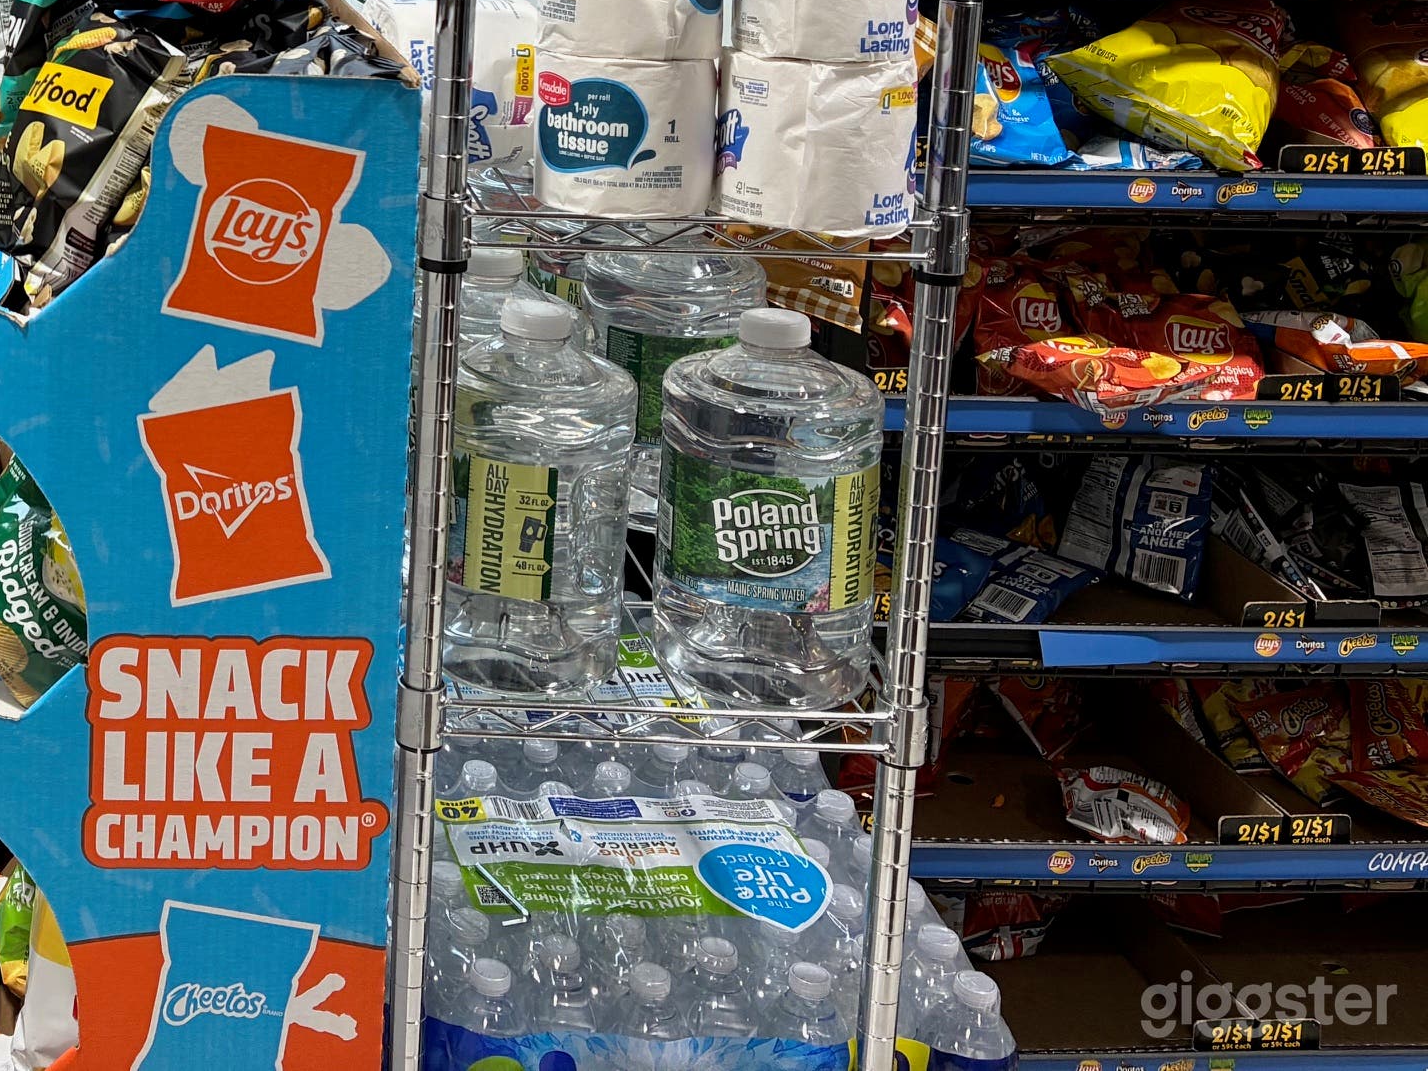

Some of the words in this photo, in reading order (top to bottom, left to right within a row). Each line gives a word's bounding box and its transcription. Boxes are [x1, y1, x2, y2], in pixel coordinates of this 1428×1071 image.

[867, 19, 904, 39] Long
[860, 36, 910, 55] Lasting
[574, 101, 600, 116] 1-ply
[587, 93, 598, 102] per
[598, 93, 611, 102] roll
[546, 108, 629, 138] bathroom
[557, 130, 609, 155] tissue
[1303, 151, 1350, 174] 2/$1
[1361, 149, 1405, 171] 2/$1
[872, 193, 904, 210] Long
[864, 205, 910, 227] Lasting
[210, 196, 313, 262] Lay's
[1225, 365, 1254, 377] Spicy
[1280, 379, 1323, 401] 2/$1
[1339, 376, 1382, 397] 2/$1
[485, 478, 509, 494] DAY
[848, 487, 865, 505] DAY
[174, 474, 293, 521] Doritos
[518, 494, 531, 505] 32
[712, 492, 819, 529] Poland
[480, 491, 506, 594] HYDRATION
[714, 522, 823, 562] Spring
[1138, 535, 1187, 549] ANGLE
[766, 554, 795, 567] 1845
[843, 503, 863, 606] HYDRATION
[18, 557, 50, 609] CREAM
[727, 580, 751, 597] MAINE
[752, 583, 780, 600] SPRING
[781, 585, 806, 602] WATER
[99, 647, 360, 721] SNACK
[102, 730, 273, 802] LIKE
[293, 732, 347, 803] A
[95, 814, 359, 861] CHAMPION
[718, 854, 788, 868] Project
[735, 868, 789, 887] Life
[735, 886, 811, 904] Pure
[772, 900, 793, 909] The
[163, 983, 266, 1026] Cheetos
